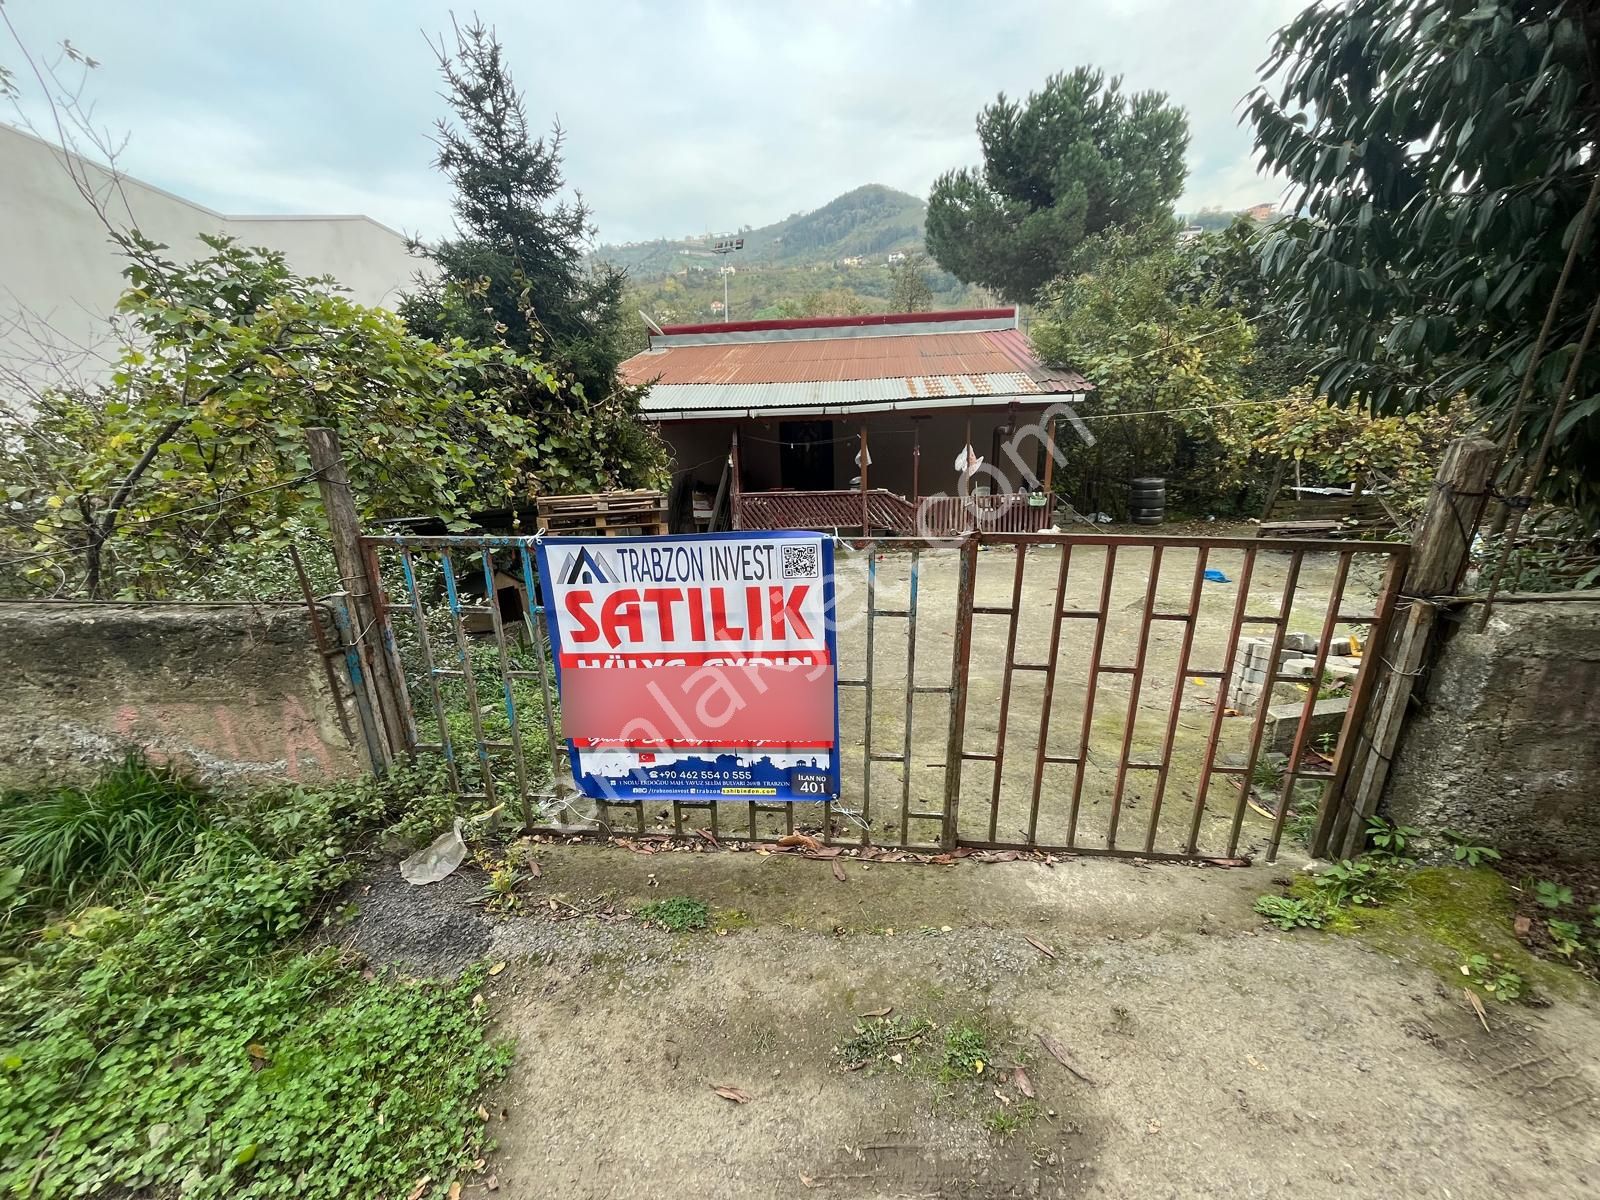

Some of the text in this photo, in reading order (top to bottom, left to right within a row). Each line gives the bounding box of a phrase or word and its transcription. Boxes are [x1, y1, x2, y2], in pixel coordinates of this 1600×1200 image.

[616, 544, 775, 583] TRABZON INVEST
[565, 586, 814, 649] SATILIK
[680, 771, 698, 779] 462
[701, 771, 720, 779] 554
[799, 782, 825, 794] 401
